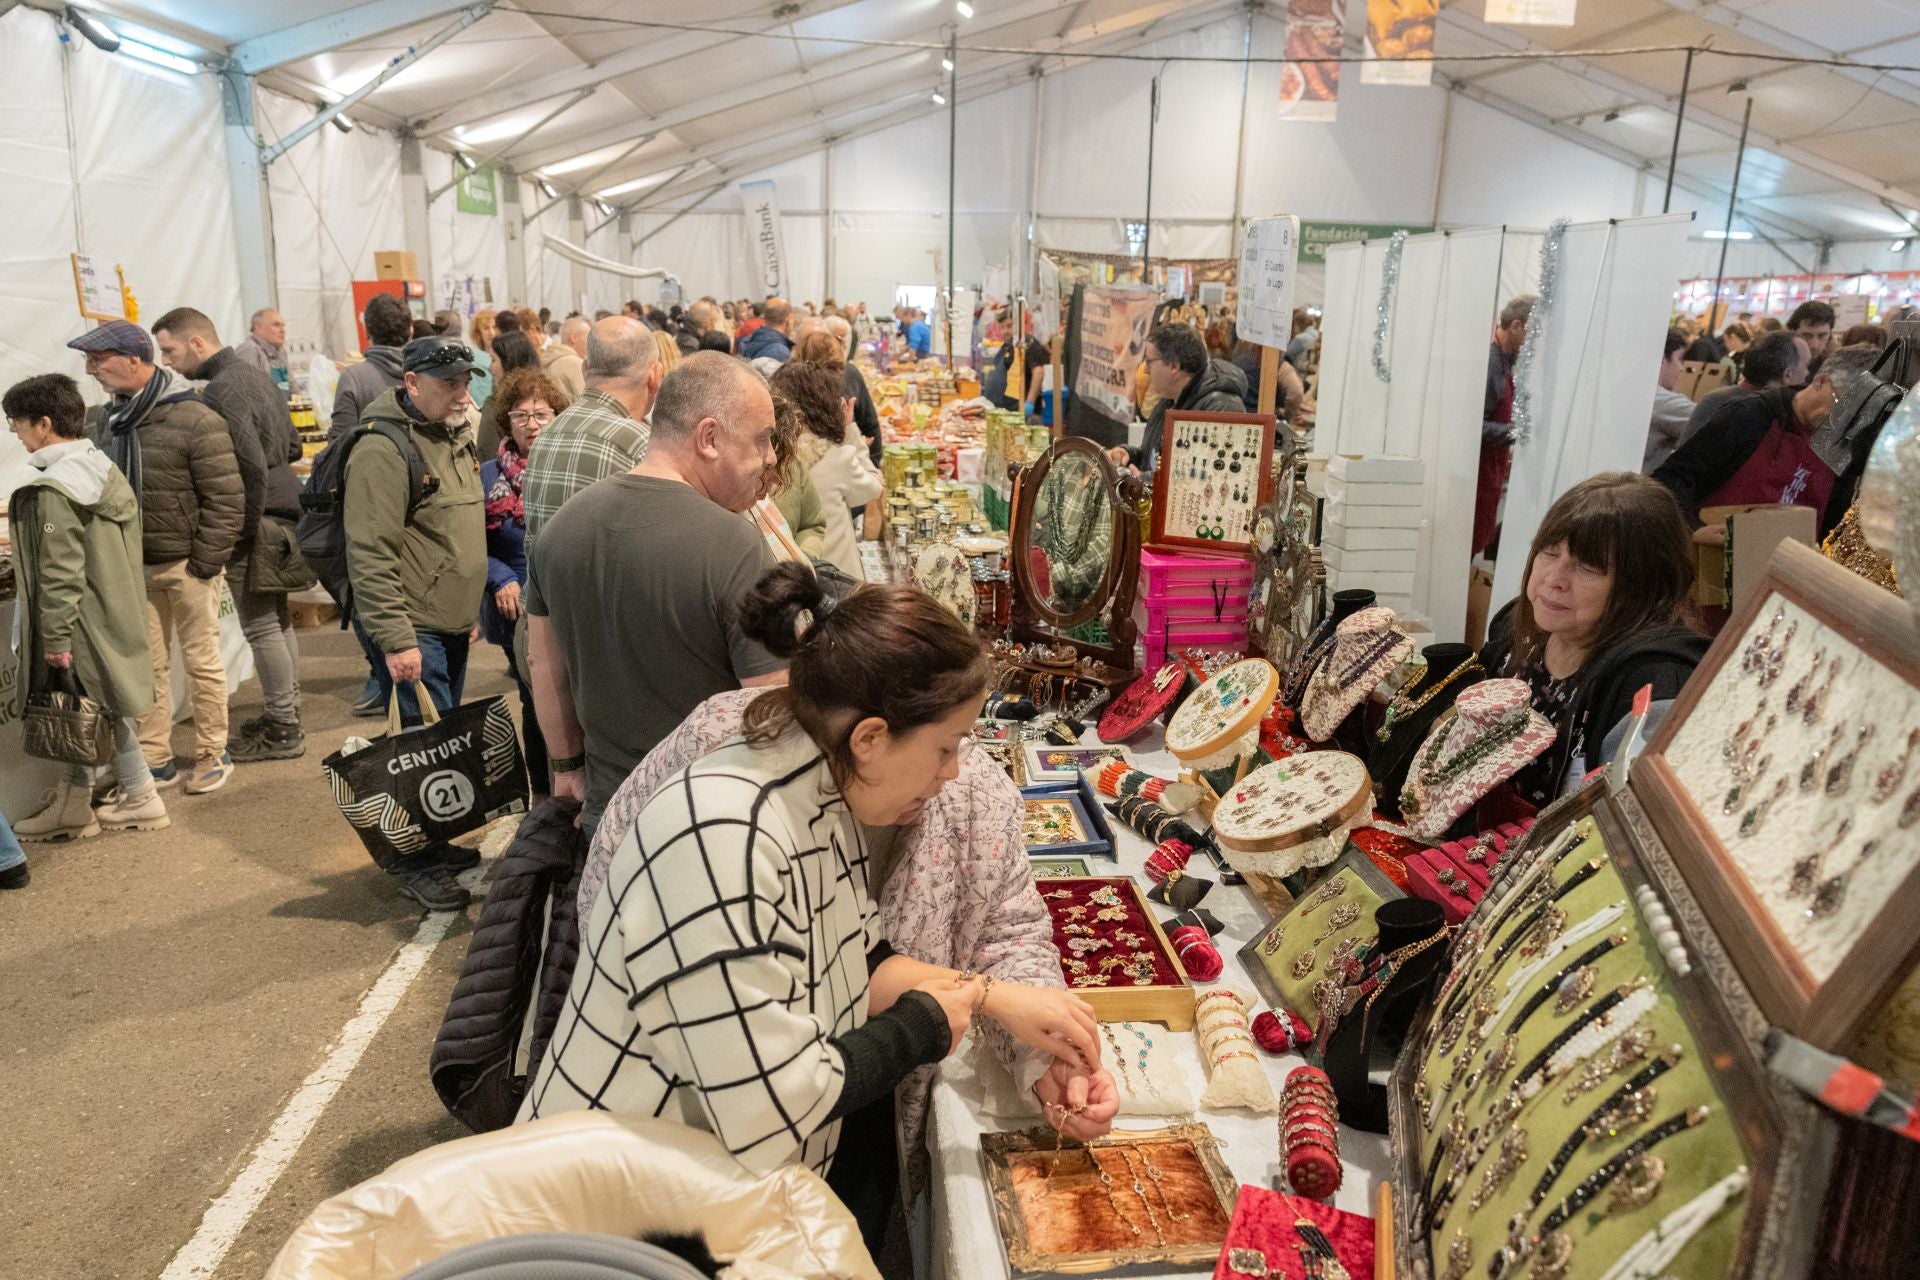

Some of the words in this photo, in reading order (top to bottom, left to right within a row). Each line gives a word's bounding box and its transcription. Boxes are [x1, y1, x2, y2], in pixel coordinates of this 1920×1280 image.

[755, 202, 780, 288] CaixaBank
[1304, 226, 1368, 240] Fundación
[387, 731, 473, 775] CENTURY
[435, 784, 462, 809] 21
